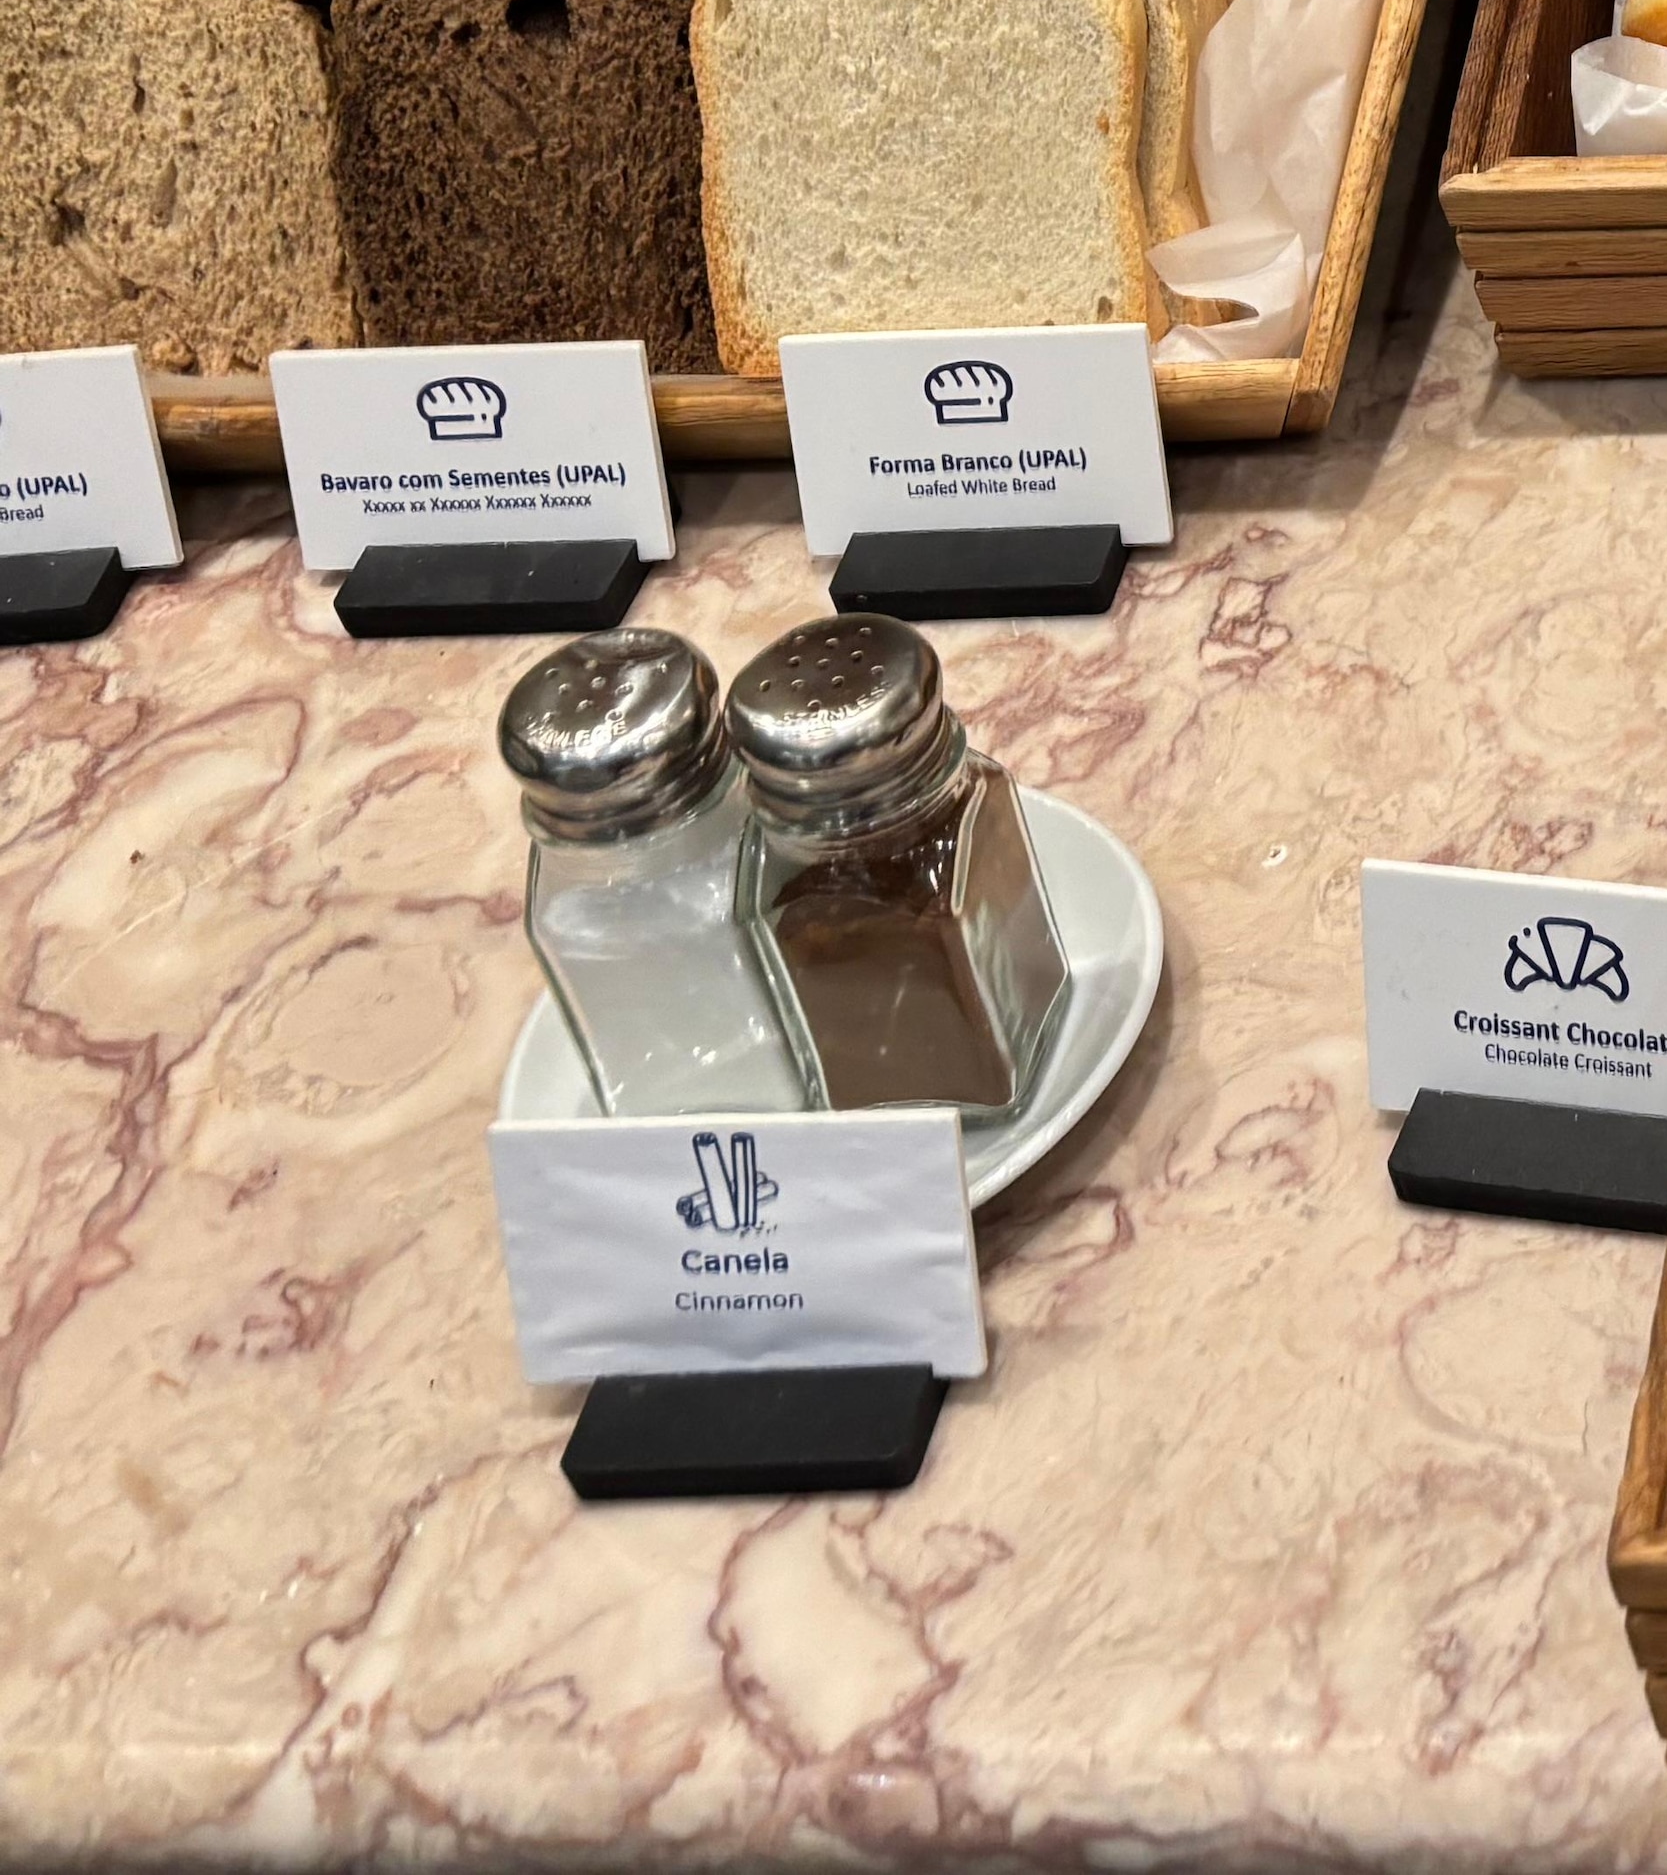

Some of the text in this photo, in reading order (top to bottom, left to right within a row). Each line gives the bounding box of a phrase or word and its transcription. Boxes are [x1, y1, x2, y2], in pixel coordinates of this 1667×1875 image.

[869, 446, 1087, 475] Forma Branco (UPAL)
[16, 472, 88, 502] (UPAL)
[320, 462, 626, 493] Bavaro com Sementes (UPAL)
[907, 476, 1057, 497] Loafed White Bread
[409, 500, 427, 513] xx
[1453, 1010, 1560, 1042] Croissant
[1484, 1041, 1652, 1079] Chocolate Croissant
[681, 1246, 789, 1275] Canela
[675, 1291, 804, 1312] Cinnamon
